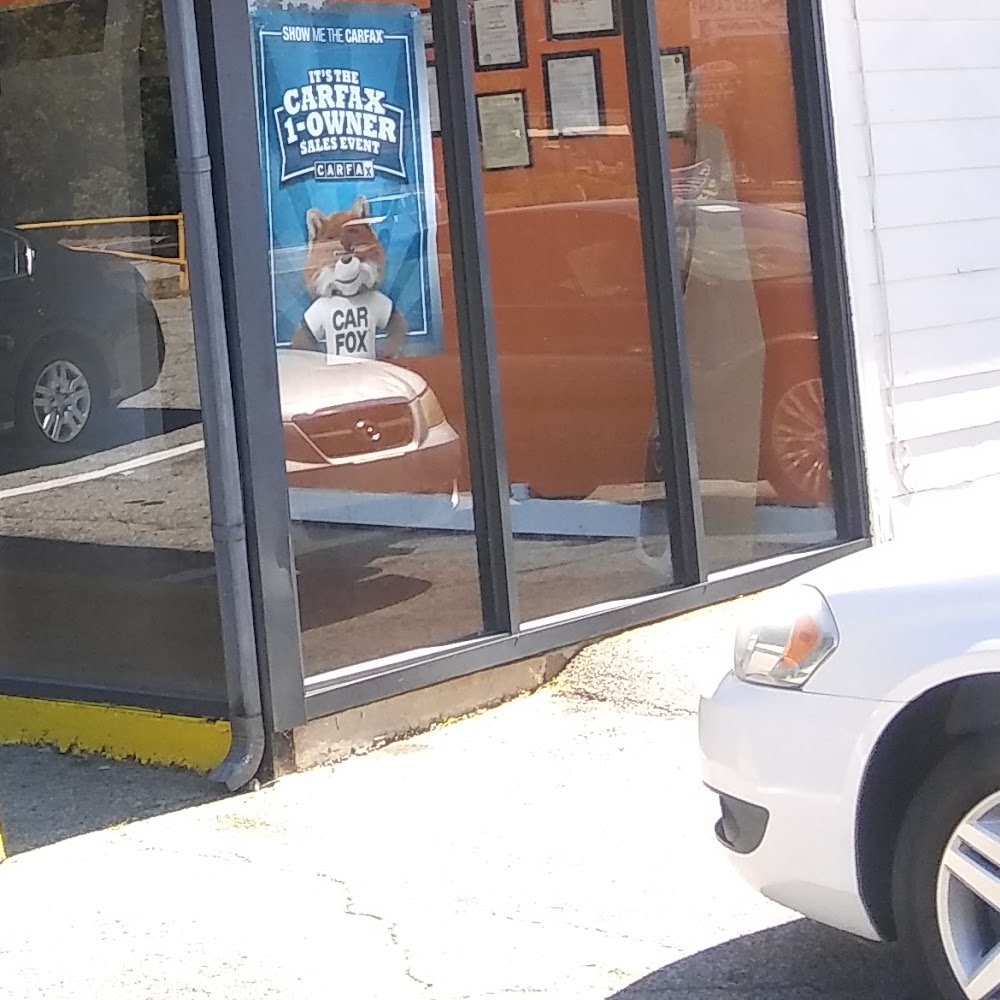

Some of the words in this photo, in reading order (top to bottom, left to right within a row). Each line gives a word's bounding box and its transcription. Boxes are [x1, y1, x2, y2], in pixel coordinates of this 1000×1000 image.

[282, 26, 311, 42] SHOW
[312, 28, 326, 43] ME
[327, 28, 344, 43] THE
[345, 29, 384, 44] CARFAX
[308, 69, 332, 84] IT'S
[335, 70, 359, 85] THE
[283, 84, 386, 116] CARFAX
[284, 110, 397, 144] 1-OWNER
[300, 137, 338, 155] SALES
[340, 137, 381, 155] EVENT
[316, 161, 373, 179] CARFAX
[333, 306, 368, 332] CAR
[335, 331, 367, 356] FOX
